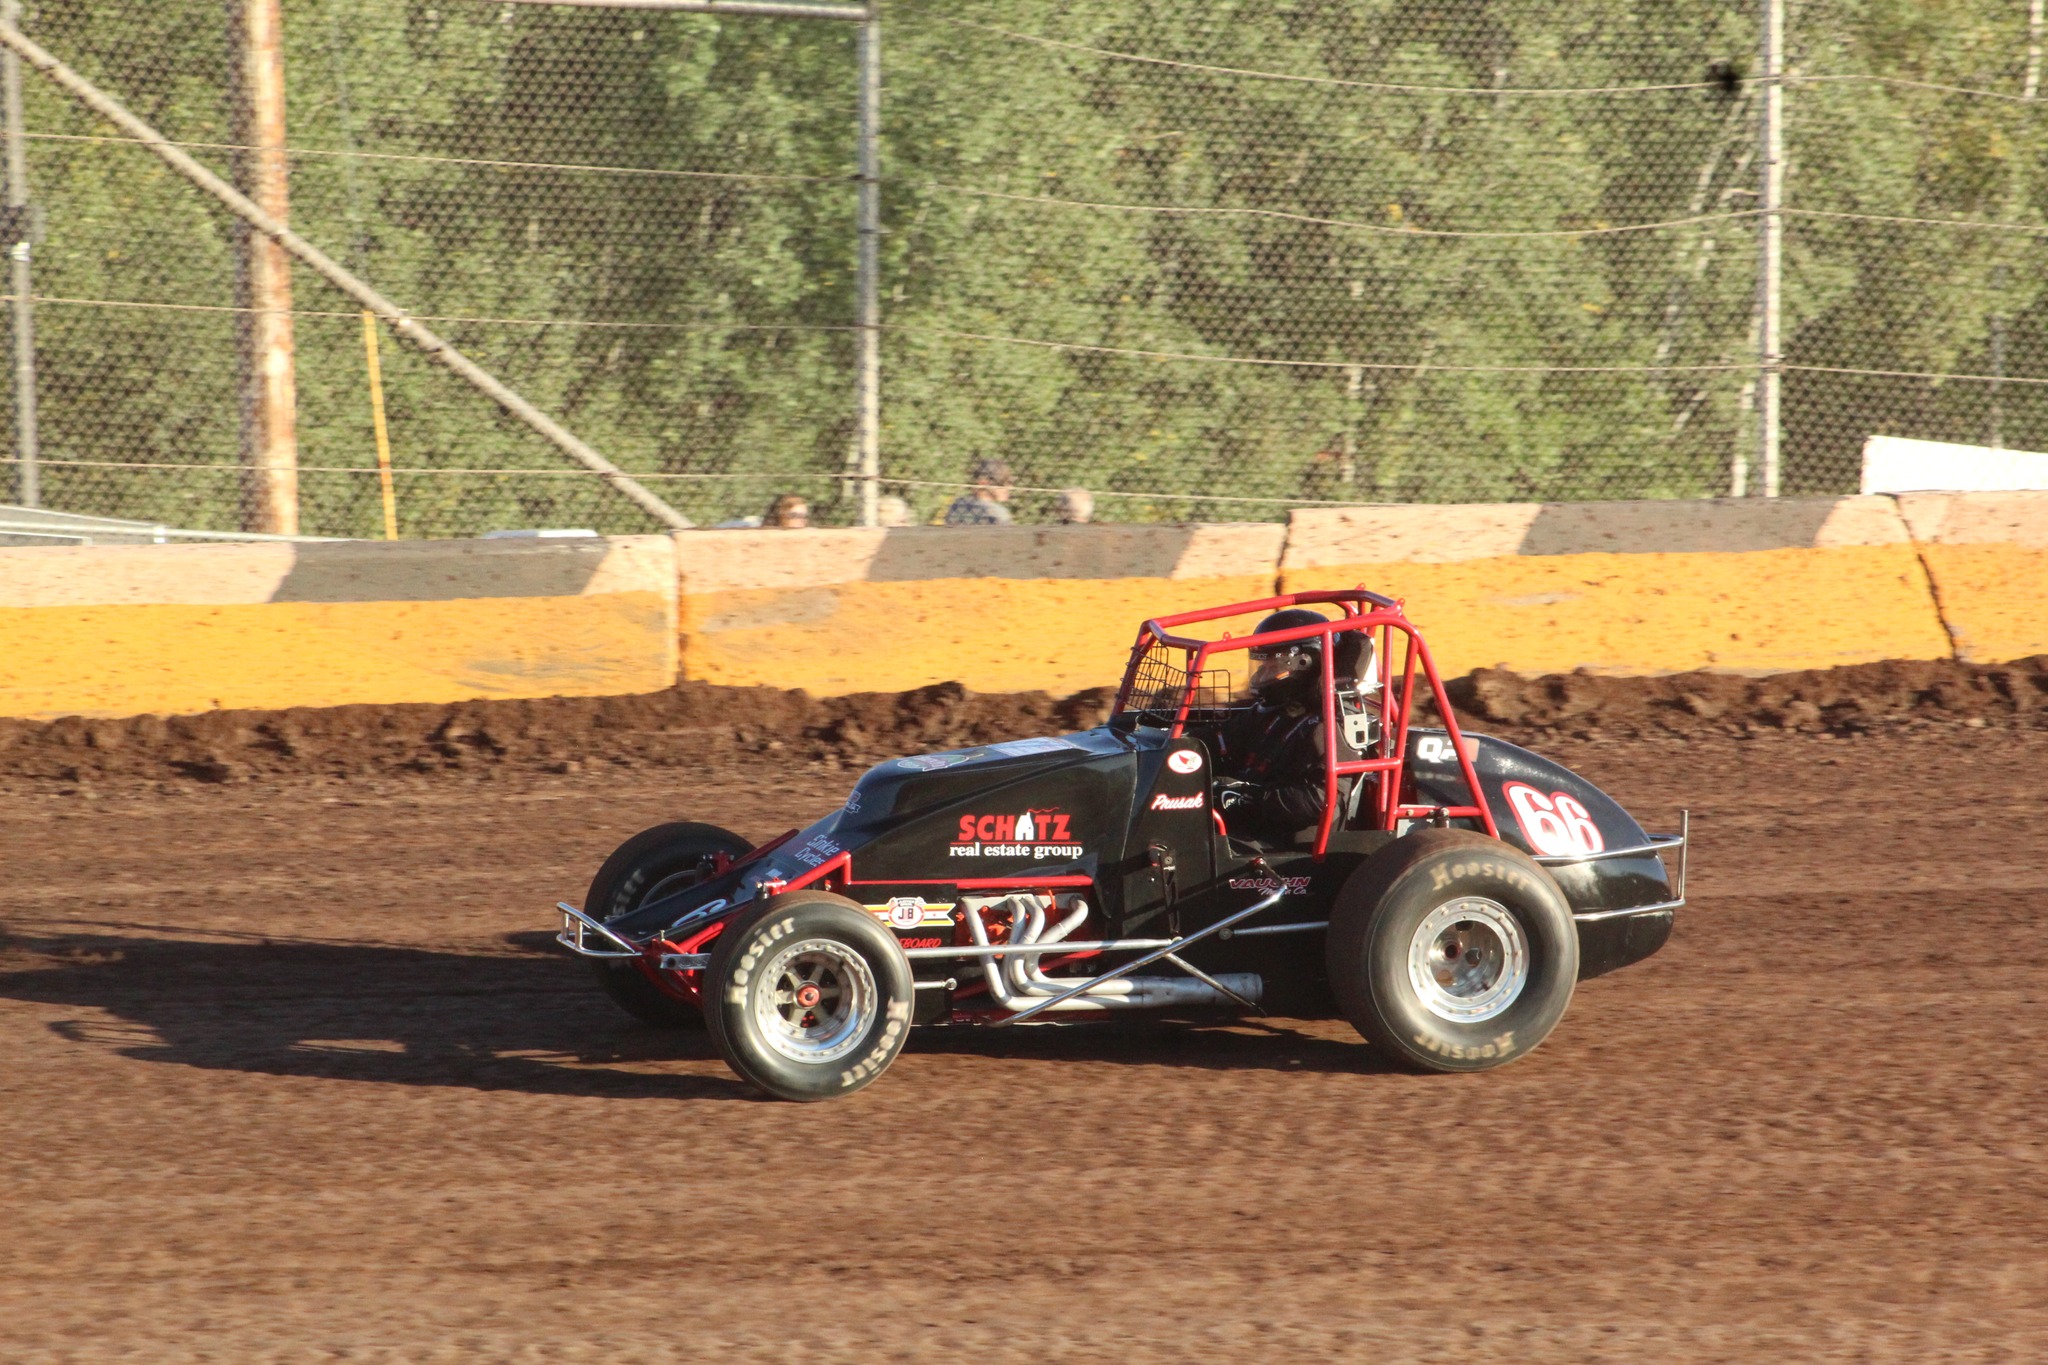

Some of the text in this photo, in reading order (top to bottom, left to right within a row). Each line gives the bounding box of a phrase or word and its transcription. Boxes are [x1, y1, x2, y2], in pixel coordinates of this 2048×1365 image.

[1151, 792, 1204, 810] Prusak
[958, 811, 1071, 841] SCHATZ
[1502, 781, 1604, 856] 66
[949, 842, 1083, 860] real estate group
